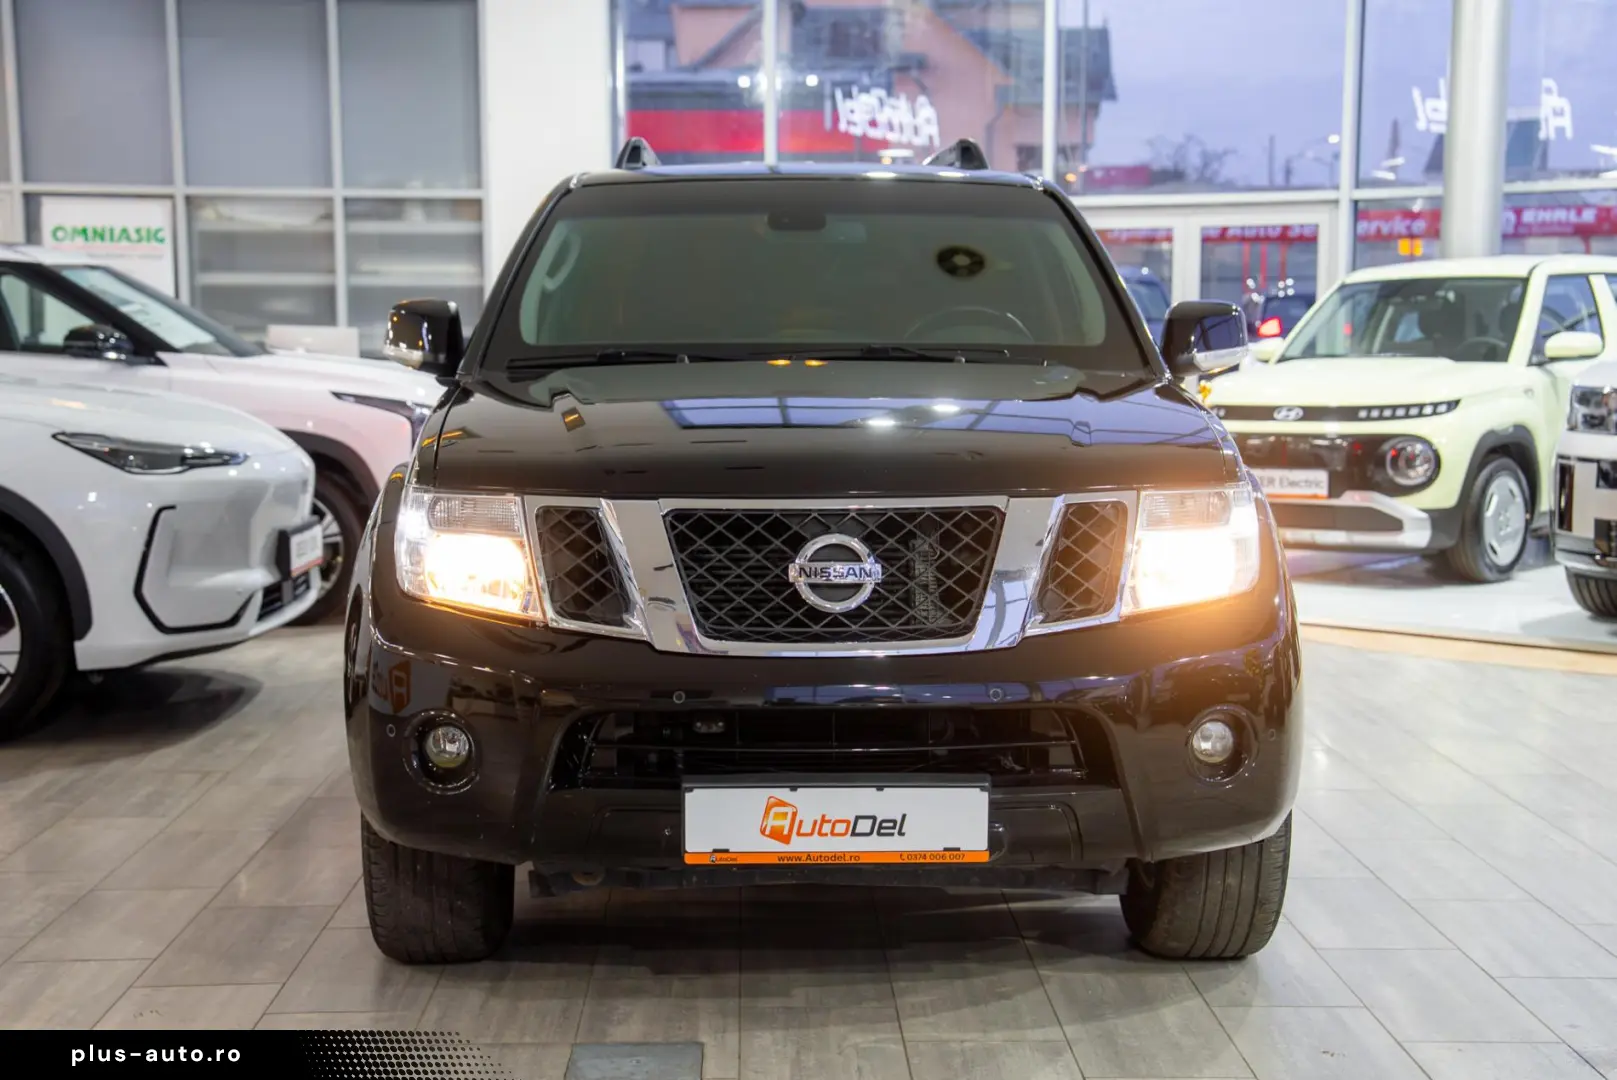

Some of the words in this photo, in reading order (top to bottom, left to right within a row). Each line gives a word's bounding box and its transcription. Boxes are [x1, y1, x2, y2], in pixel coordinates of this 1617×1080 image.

[51, 225, 166, 245] OMNIASIG
[798, 566, 872, 579] NISSAN
[761, 801, 907, 840] AutoDel
[777, 853, 861, 863] www.Autodel.ro
[906, 853, 927, 861] 0374
[929, 853, 947, 861] 006
[948, 852, 966, 861] 007
